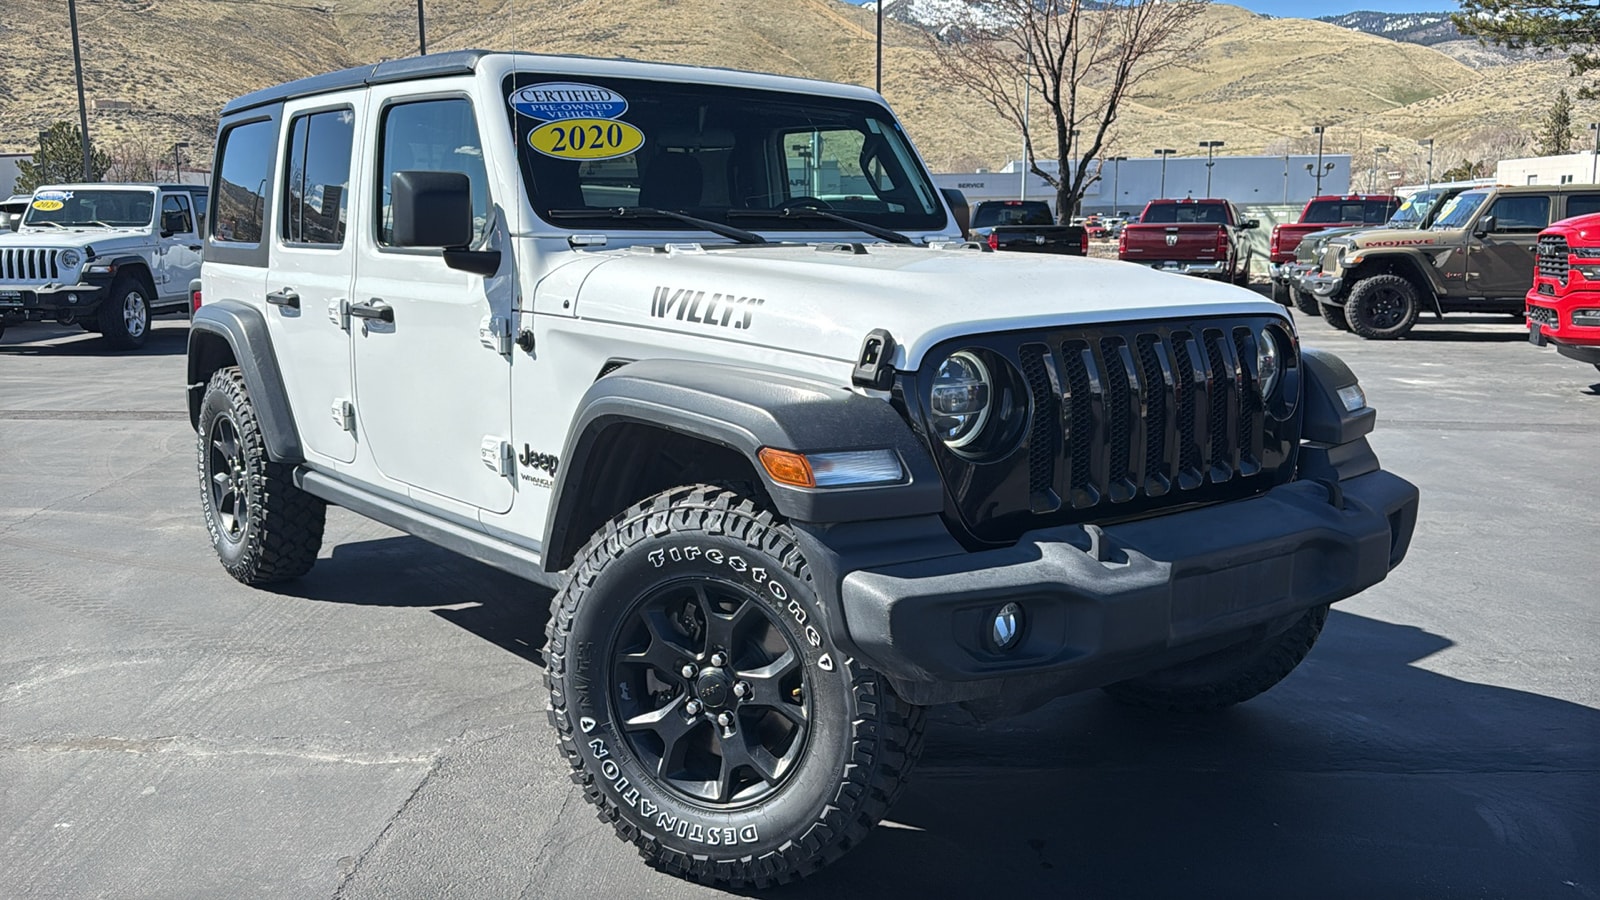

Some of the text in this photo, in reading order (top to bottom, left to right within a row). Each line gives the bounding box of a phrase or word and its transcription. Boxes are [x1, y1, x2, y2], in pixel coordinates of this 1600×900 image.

[520, 90, 611, 103] CERTIFIED
[531, 103, 613, 112] PRE-OWNED
[547, 110, 606, 118] VEHICLE
[550, 123, 623, 152] 2020
[36, 201, 60, 209] 2020
[1365, 238, 1435, 248] MOJAVE
[650, 285, 765, 330] WILLYS
[518, 442, 559, 478] Jeep
[588, 738, 760, 846] DESTINATION
